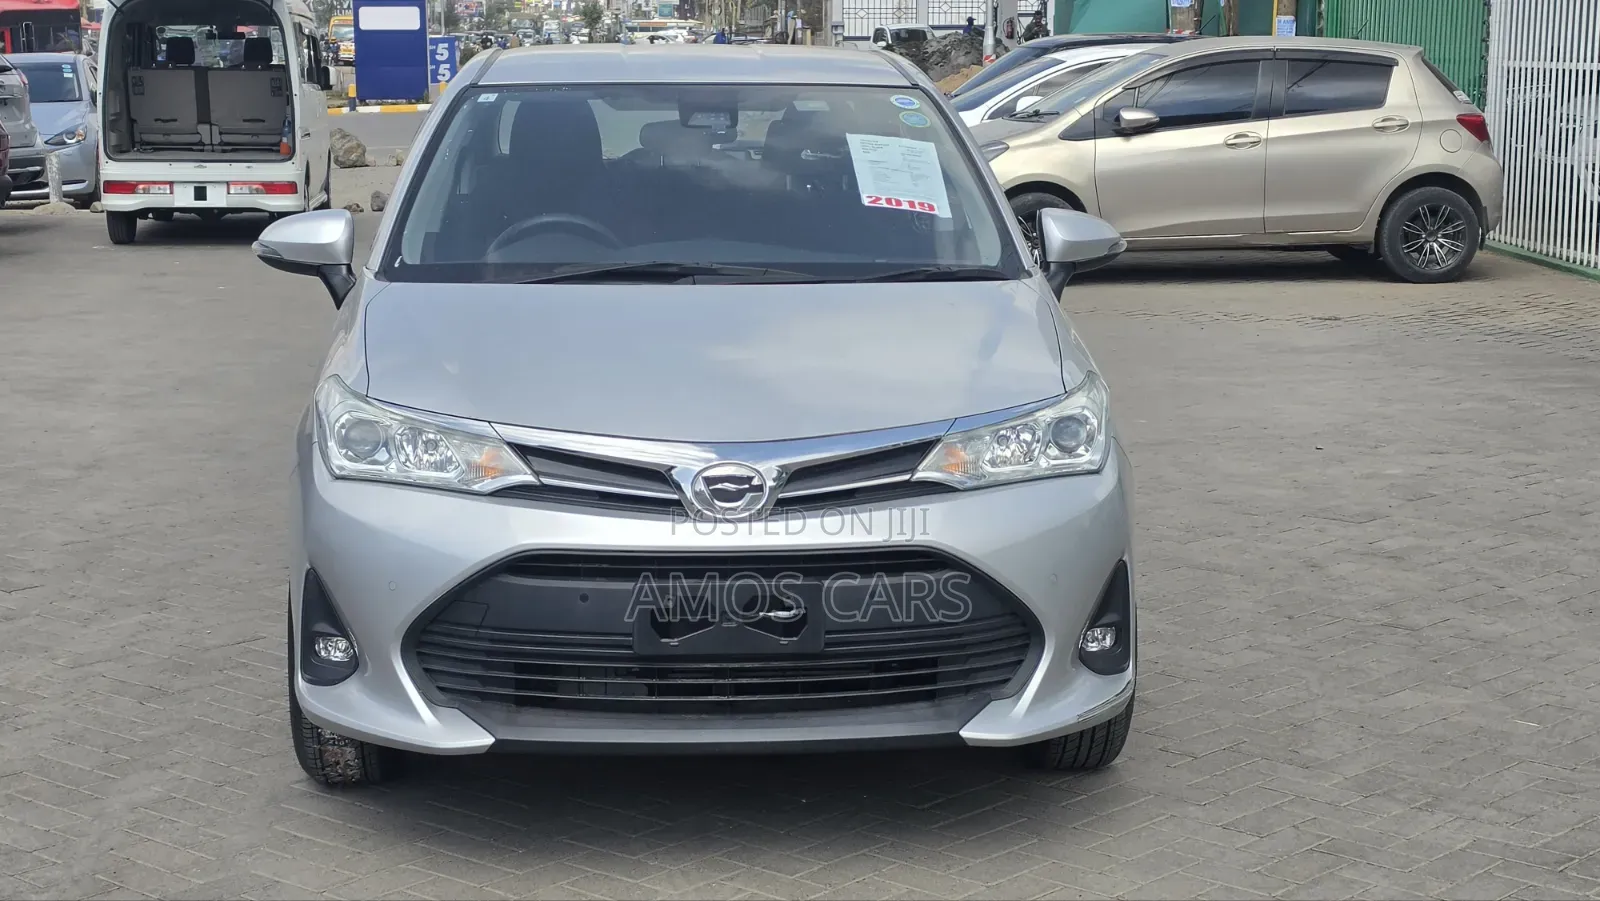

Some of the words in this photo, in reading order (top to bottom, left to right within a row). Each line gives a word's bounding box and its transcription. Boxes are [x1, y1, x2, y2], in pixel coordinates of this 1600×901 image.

[435, 43, 449, 61] 5
[437, 64, 451, 81] 5
[865, 195, 936, 212] 2019
